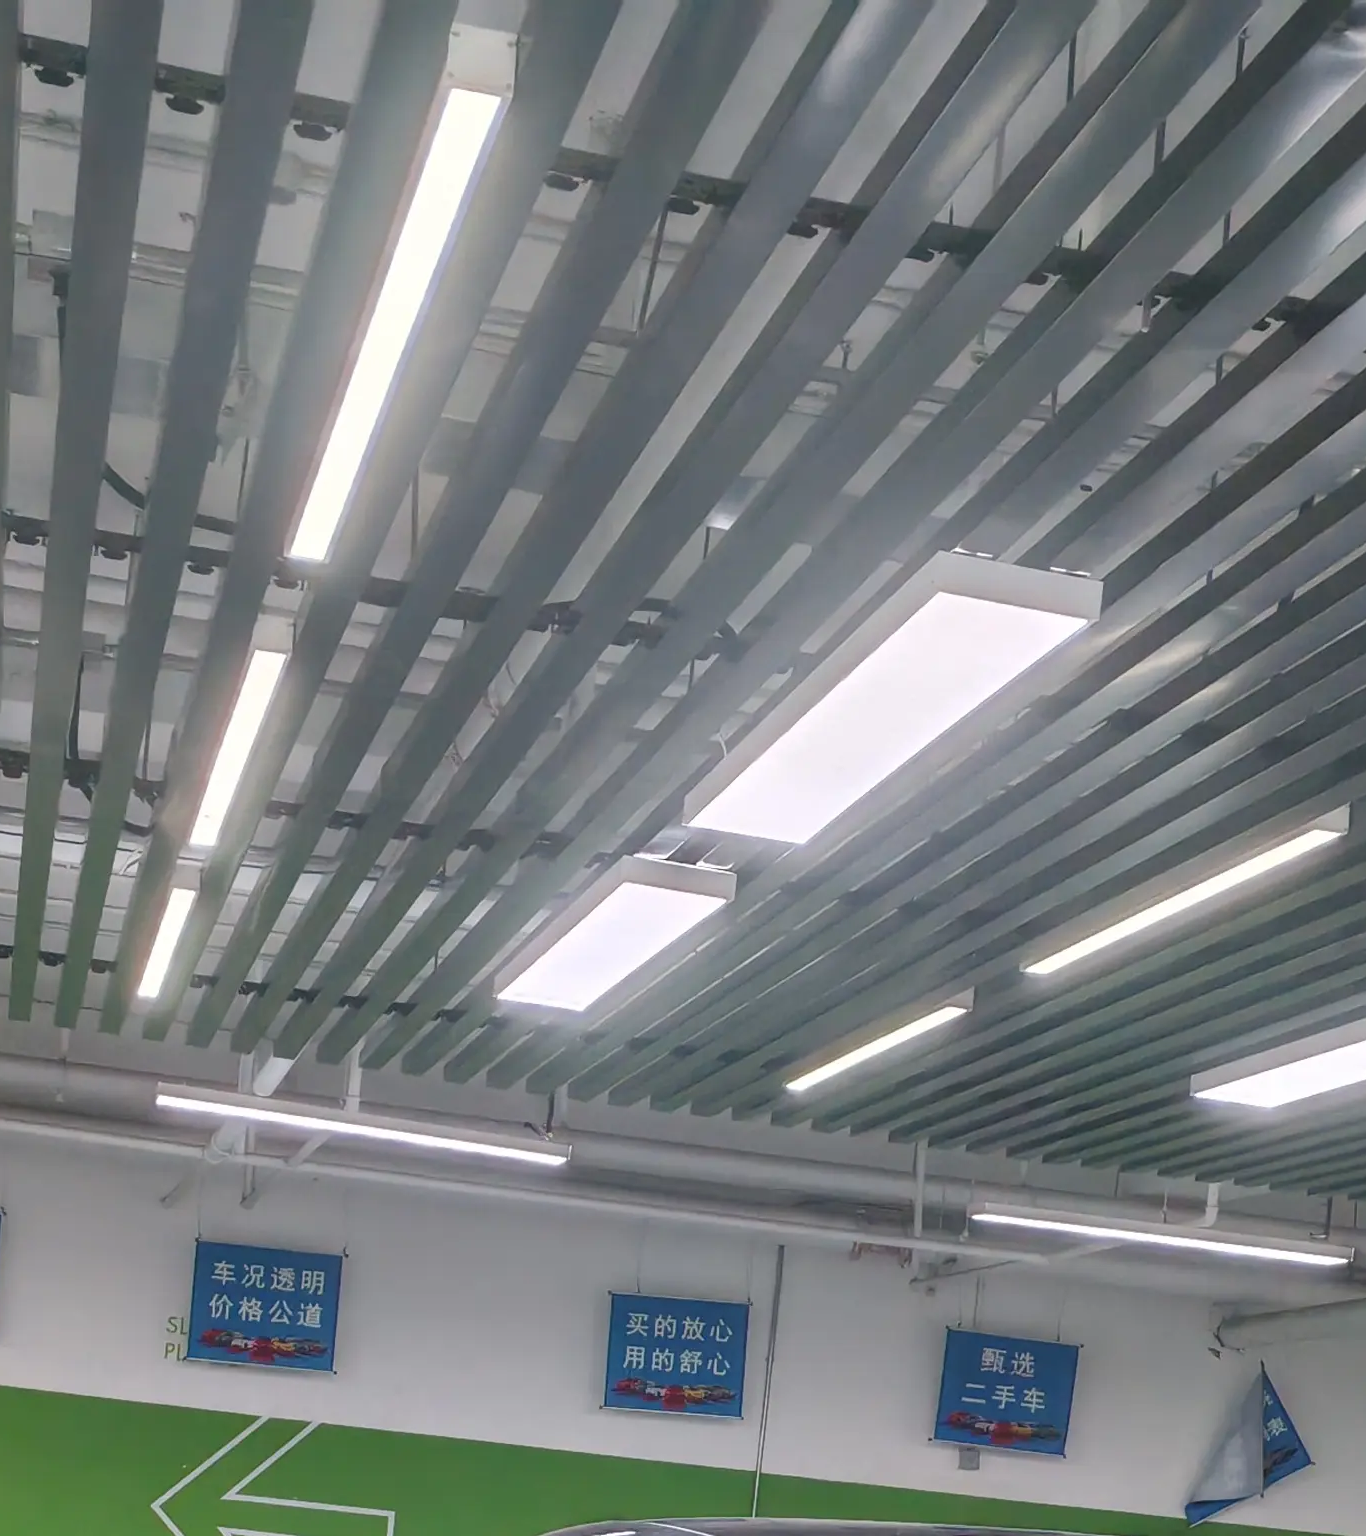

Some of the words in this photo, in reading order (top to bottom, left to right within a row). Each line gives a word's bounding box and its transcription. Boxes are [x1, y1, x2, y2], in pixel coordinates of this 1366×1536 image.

[211, 1260, 325, 1295] 车况透明
[209, 1293, 323, 1329] 价格公道
[626, 1312, 733, 1343] 买的放心
[623, 1345, 731, 1376] 用的舒心
[980, 1347, 1035, 1378] 甄选
[961, 1383, 1046, 1414] 二手车
